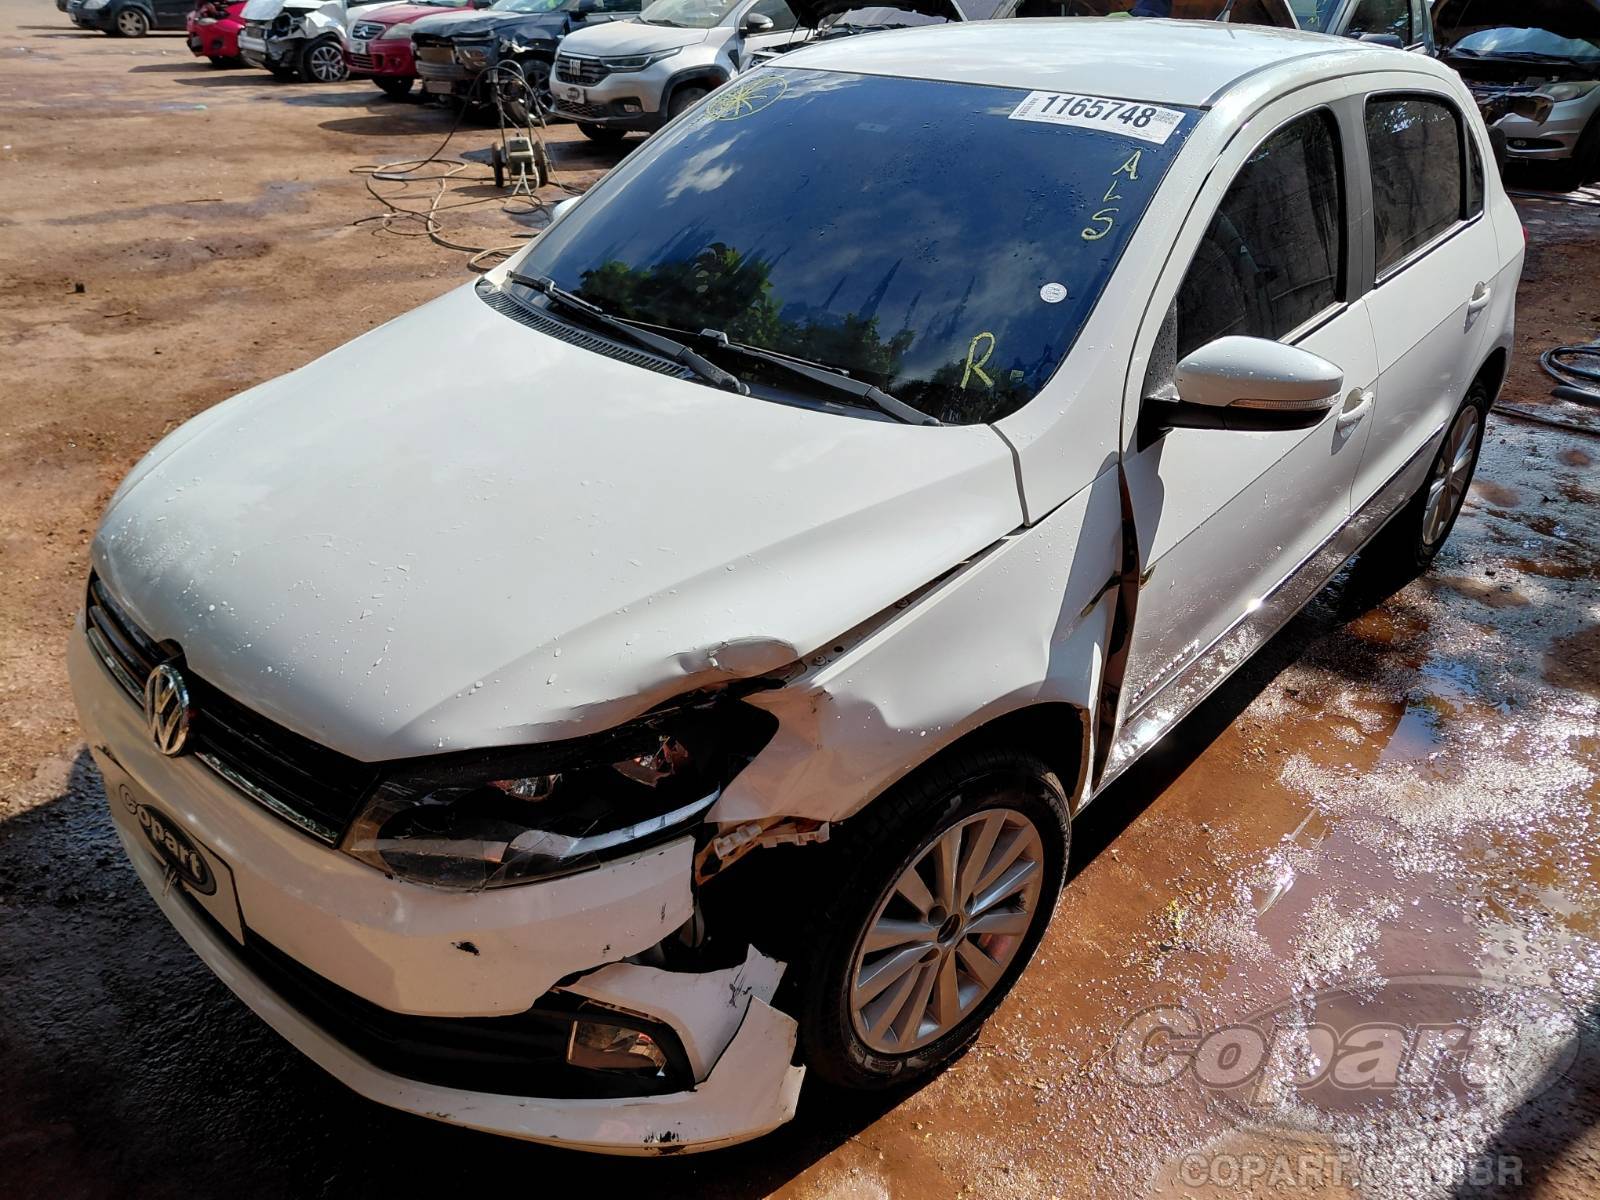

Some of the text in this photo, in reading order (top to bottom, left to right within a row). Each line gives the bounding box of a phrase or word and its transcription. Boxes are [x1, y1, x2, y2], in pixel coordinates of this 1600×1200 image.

[1041, 95, 1157, 128] 1165748
[960, 332, 996, 389] R
[119, 784, 201, 880] Copart
